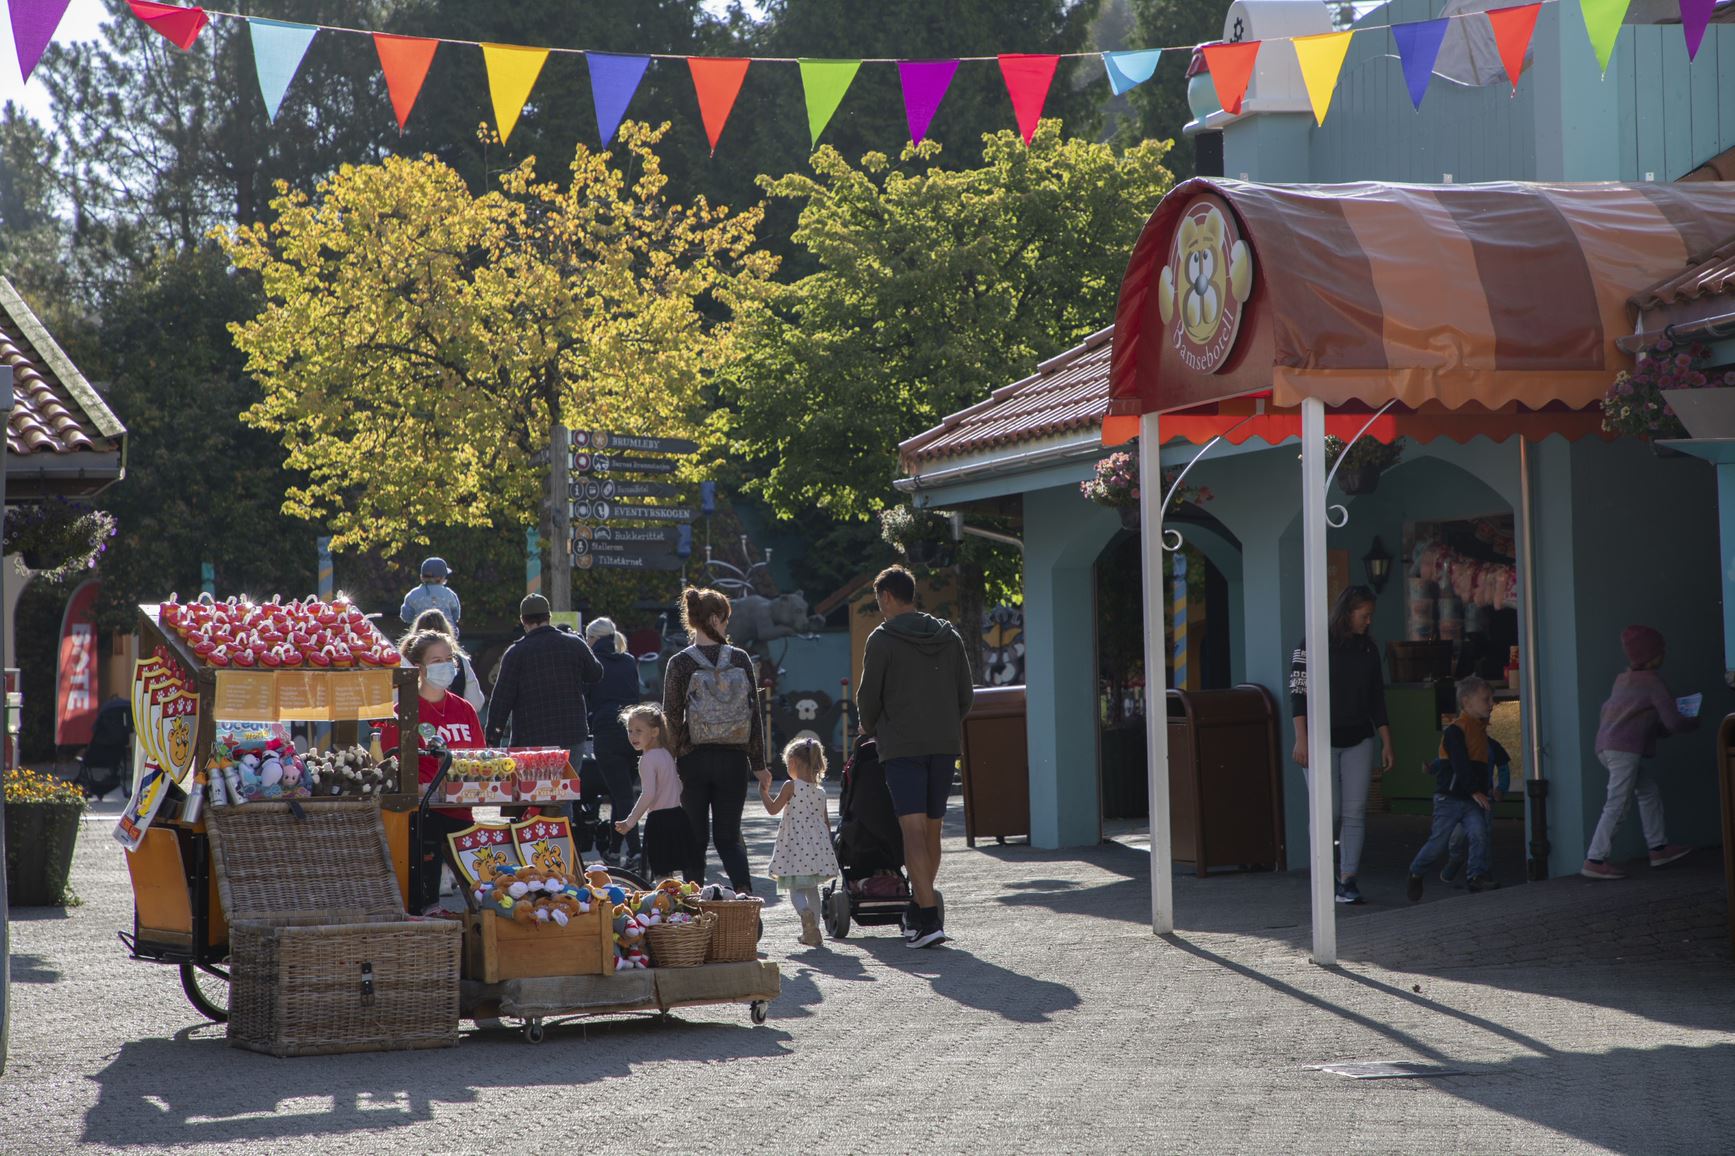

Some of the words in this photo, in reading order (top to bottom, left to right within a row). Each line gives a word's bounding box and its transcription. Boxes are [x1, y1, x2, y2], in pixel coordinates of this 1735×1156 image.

[1173, 308, 1233, 369] Bamseborell
[611, 437, 660, 449] BRUMLEBY
[614, 507, 690, 518] EVENTYRSKOGEN
[428, 723, 472, 743] OTE
